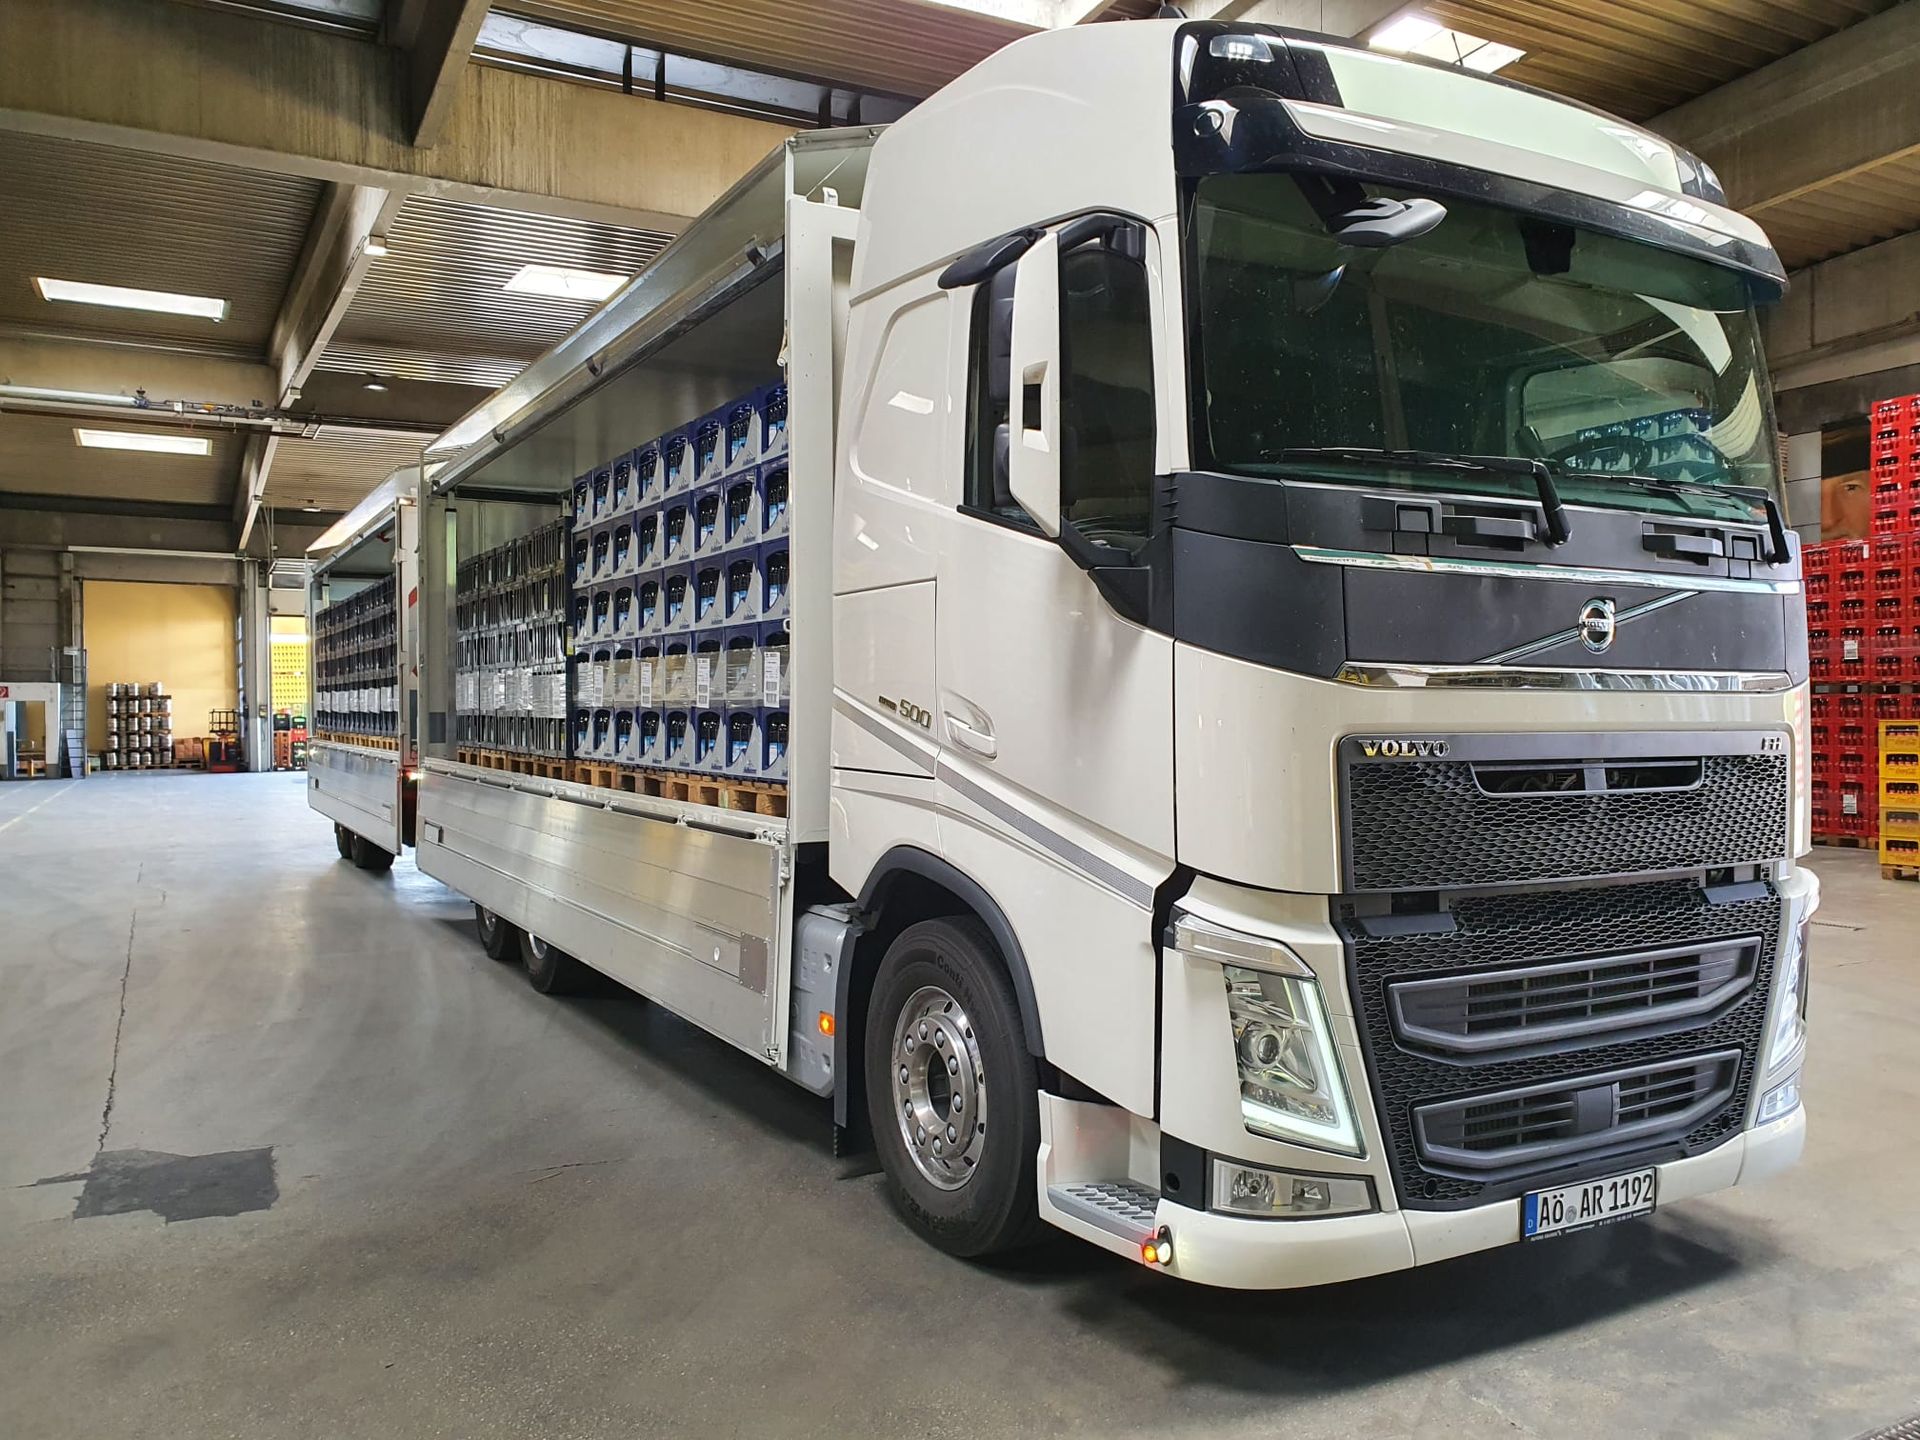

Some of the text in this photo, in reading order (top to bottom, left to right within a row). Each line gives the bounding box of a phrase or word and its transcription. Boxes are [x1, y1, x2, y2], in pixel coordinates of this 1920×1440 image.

[899, 698, 932, 729] 500
[1358, 739, 1450, 757] VOLVO
[1527, 1174, 1653, 1229] D AÖ AR 1192
